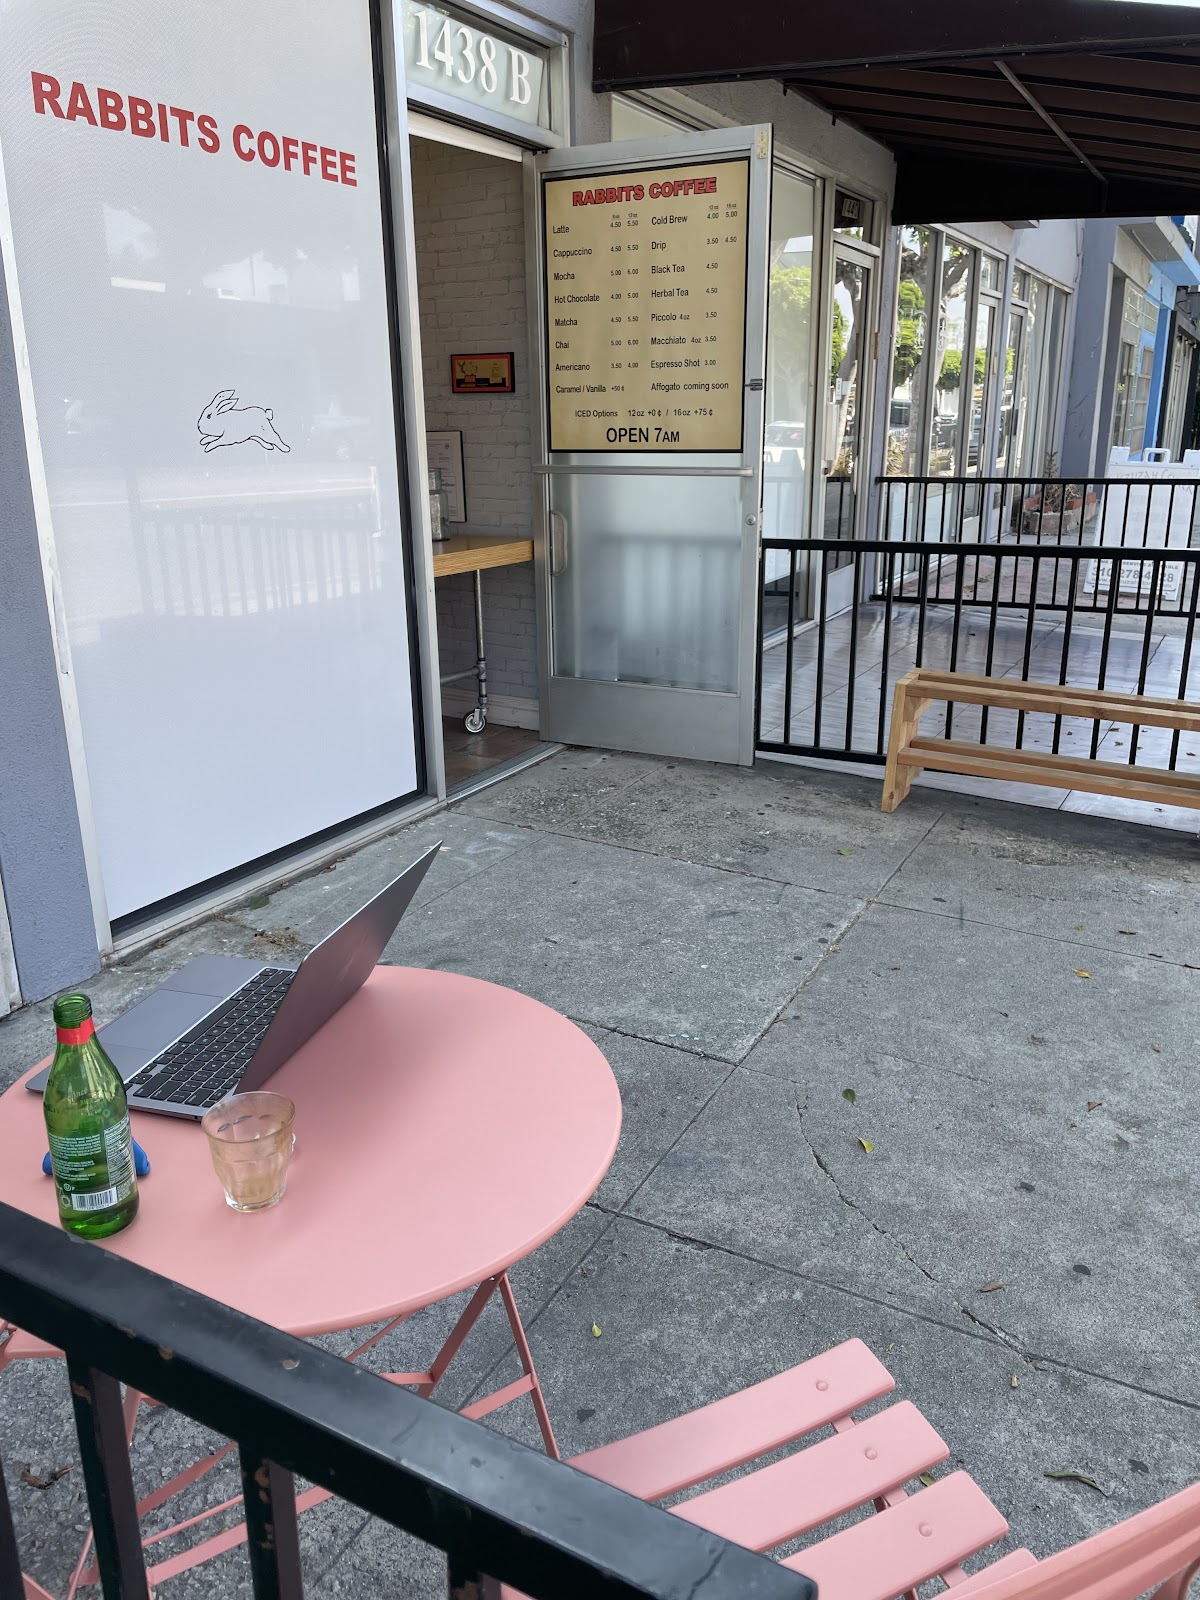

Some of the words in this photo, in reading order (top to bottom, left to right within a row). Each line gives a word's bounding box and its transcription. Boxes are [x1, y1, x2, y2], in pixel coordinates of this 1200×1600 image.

[414, 10, 498, 93] 1438
[509, 48, 531, 105] B
[30, 71, 220, 154] RABBITS
[233, 124, 358, 187] COFFEE
[572, 185, 644, 206] RABBITS
[649, 177, 717, 198] COFFEE
[652, 216, 668, 225] Cold
[670, 215, 688, 224] Brew
[553, 225, 569, 234] Latte
[652, 241, 666, 251] Drip
[553, 247, 592, 258] Cappuccino
[651, 265, 670, 274] Black
[672, 264, 685, 272] Tea
[554, 272, 575, 280] Mocha
[651, 289, 674, 298] Herbal
[676, 288, 689, 296] Tea
[567, 294, 600, 303] Chocolate
[555, 318, 578, 326] Matcha
[651, 313, 676, 321] Piccolo
[651, 336, 686, 345] Macchiato
[555, 363, 590, 371] Americano
[651, 360, 682, 369] Espresso
[684, 359, 700, 367] Shot
[556, 385, 581, 393] Caramel
[651, 383, 680, 392] Affogato
[684, 382, 709, 391] coming
[592, 409, 618, 418] Options
[606, 427, 648, 442] OPEN
[654, 427, 680, 442] 7AM
